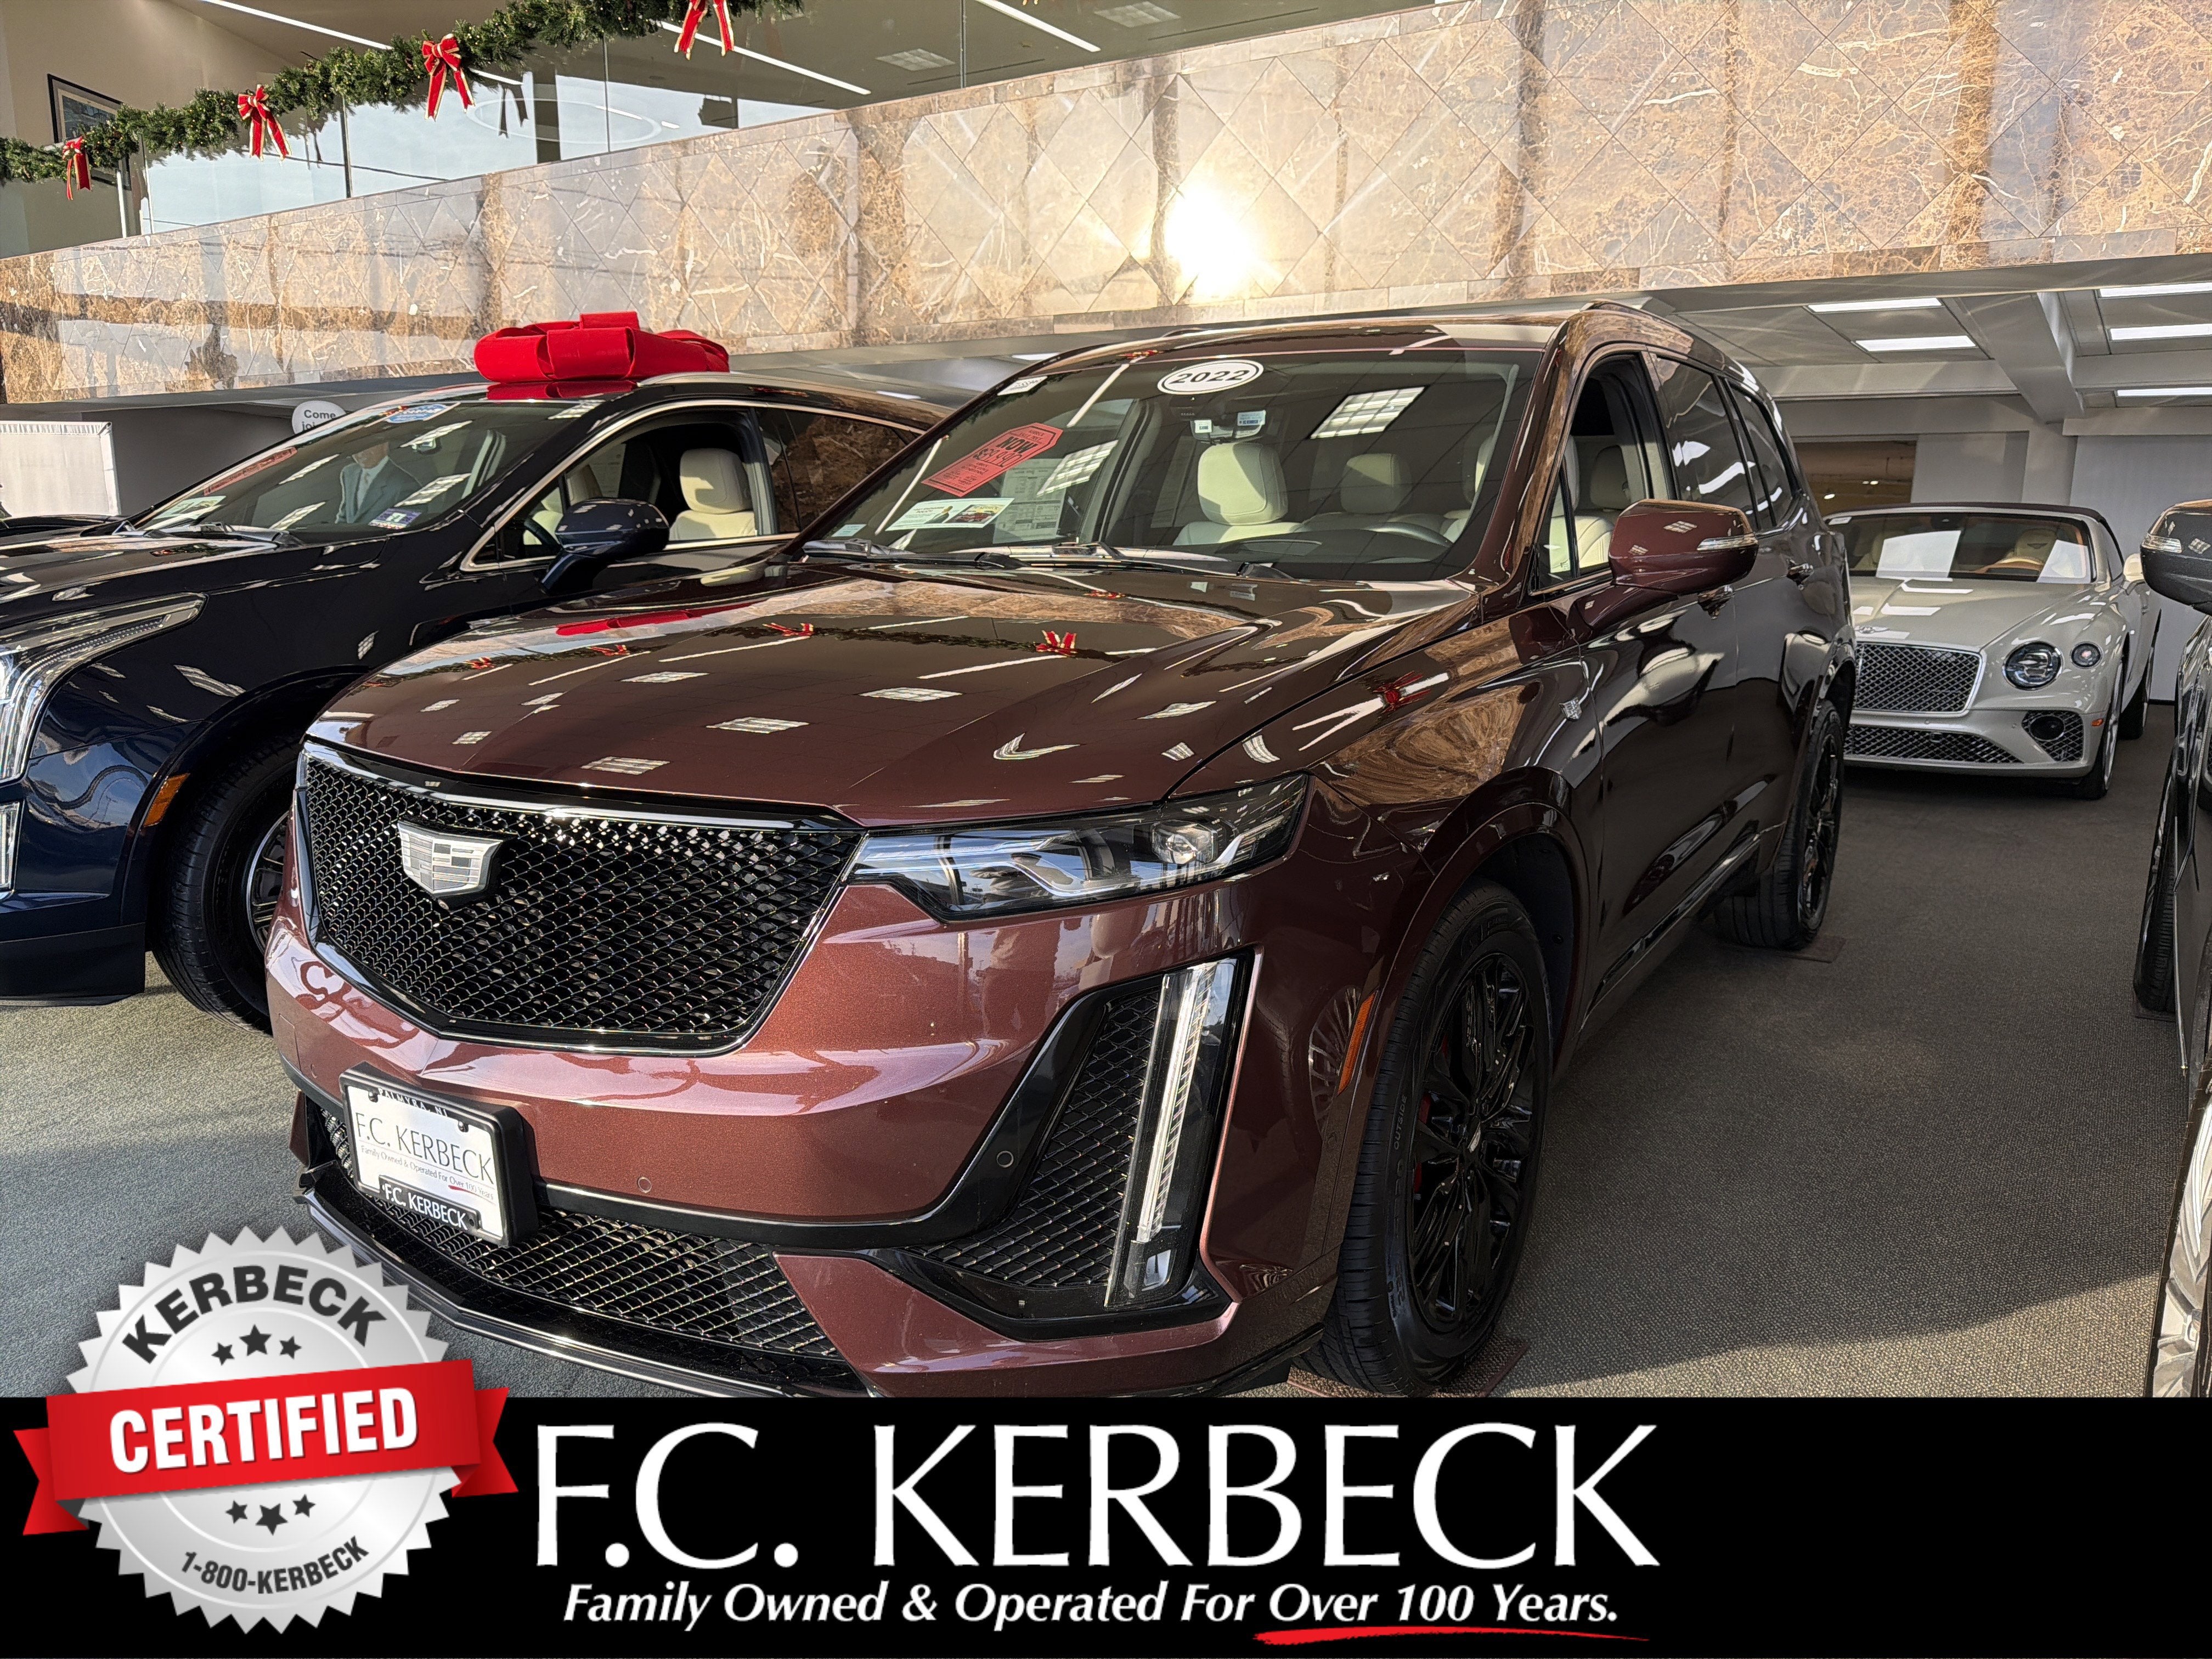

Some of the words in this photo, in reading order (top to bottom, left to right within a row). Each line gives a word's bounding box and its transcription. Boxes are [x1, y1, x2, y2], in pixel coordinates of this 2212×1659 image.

[1169, 368, 1251, 385] 2022
[304, 409, 336, 419] Come
[996, 436, 1039, 454] NOW
[1393, 1094, 1408, 1150] OUTSIDE
[355, 1112, 391, 1147] F.C.
[396, 1125, 494, 1185] KERBECK
[361, 1146, 380, 1159] Family
[381, 1152, 403, 1165] Owned
[410, 1161, 438, 1179] Operated
[438, 1171, 448, 1182] For
[449, 1176, 465, 1188] Over
[465, 1182, 477, 1193] 100
[384, 1183, 407, 1207] F.C.
[408, 1193, 468, 1231] KERBECK
